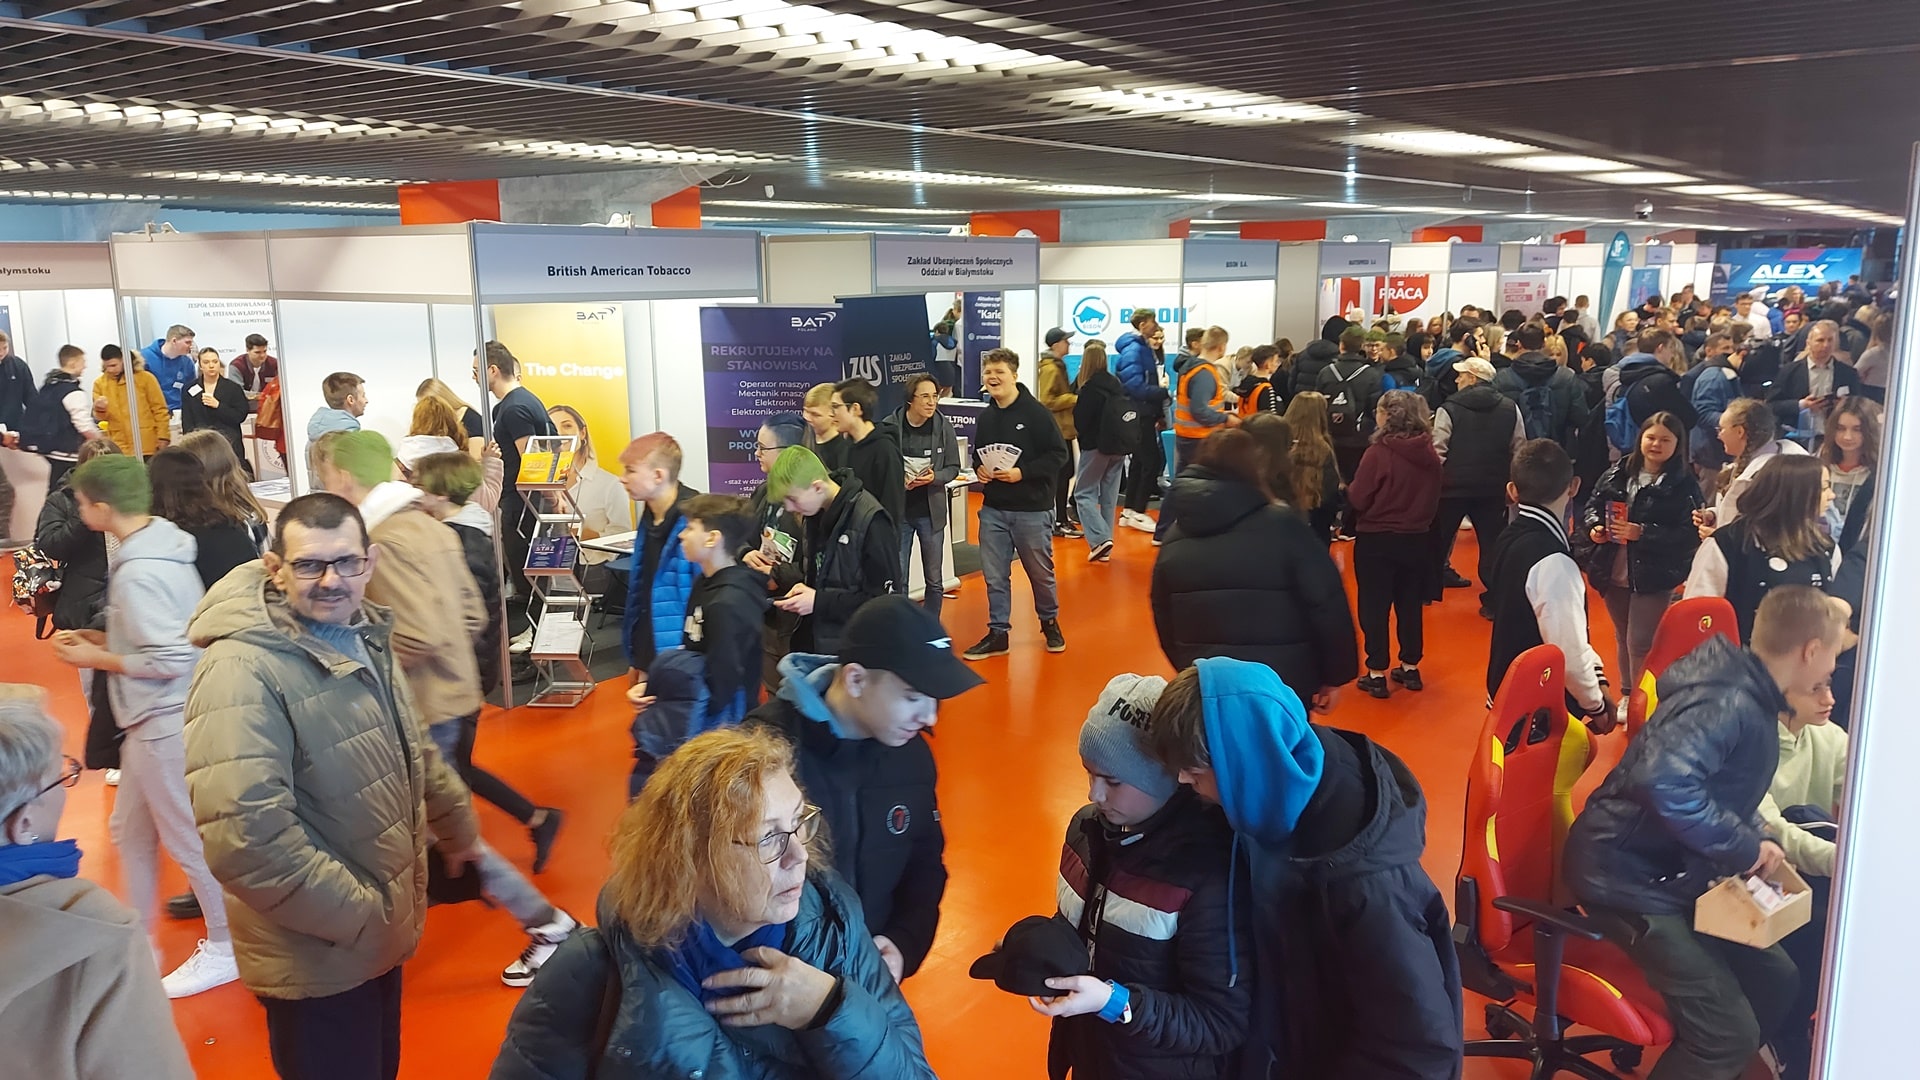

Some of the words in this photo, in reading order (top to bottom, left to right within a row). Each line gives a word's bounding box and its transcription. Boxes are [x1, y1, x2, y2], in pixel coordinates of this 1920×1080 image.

[907, 256, 931, 265] Zakład
[975, 257, 1014, 267] Społecznych
[547, 265, 587, 277] British
[590, 265, 644, 276] American
[647, 265, 691, 276] Tobacco
[921, 267, 946, 276] Oddział
[955, 267, 994, 277] Białymstoku
[1750, 263, 1829, 279] ALEX
[1378, 287, 1424, 300] PRACA
[576, 311, 607, 321] BAT
[791, 316, 827, 328] BAT
[711, 345, 810, 356] REKRUTUJEMY
[813, 346, 833, 356] NA
[889, 352, 912, 362] ZAKŁAD
[727, 360, 818, 371] STANOWISKA
[848, 354, 882, 387] ZUS
[525, 363, 558, 377] The
[559, 363, 625, 380] Change
[739, 380, 777, 389] Operator
[738, 389, 780, 397] Mechanik
[780, 391, 807, 399] maszy
[754, 398, 797, 407] Elektronik
[739, 429, 758, 438] WY
